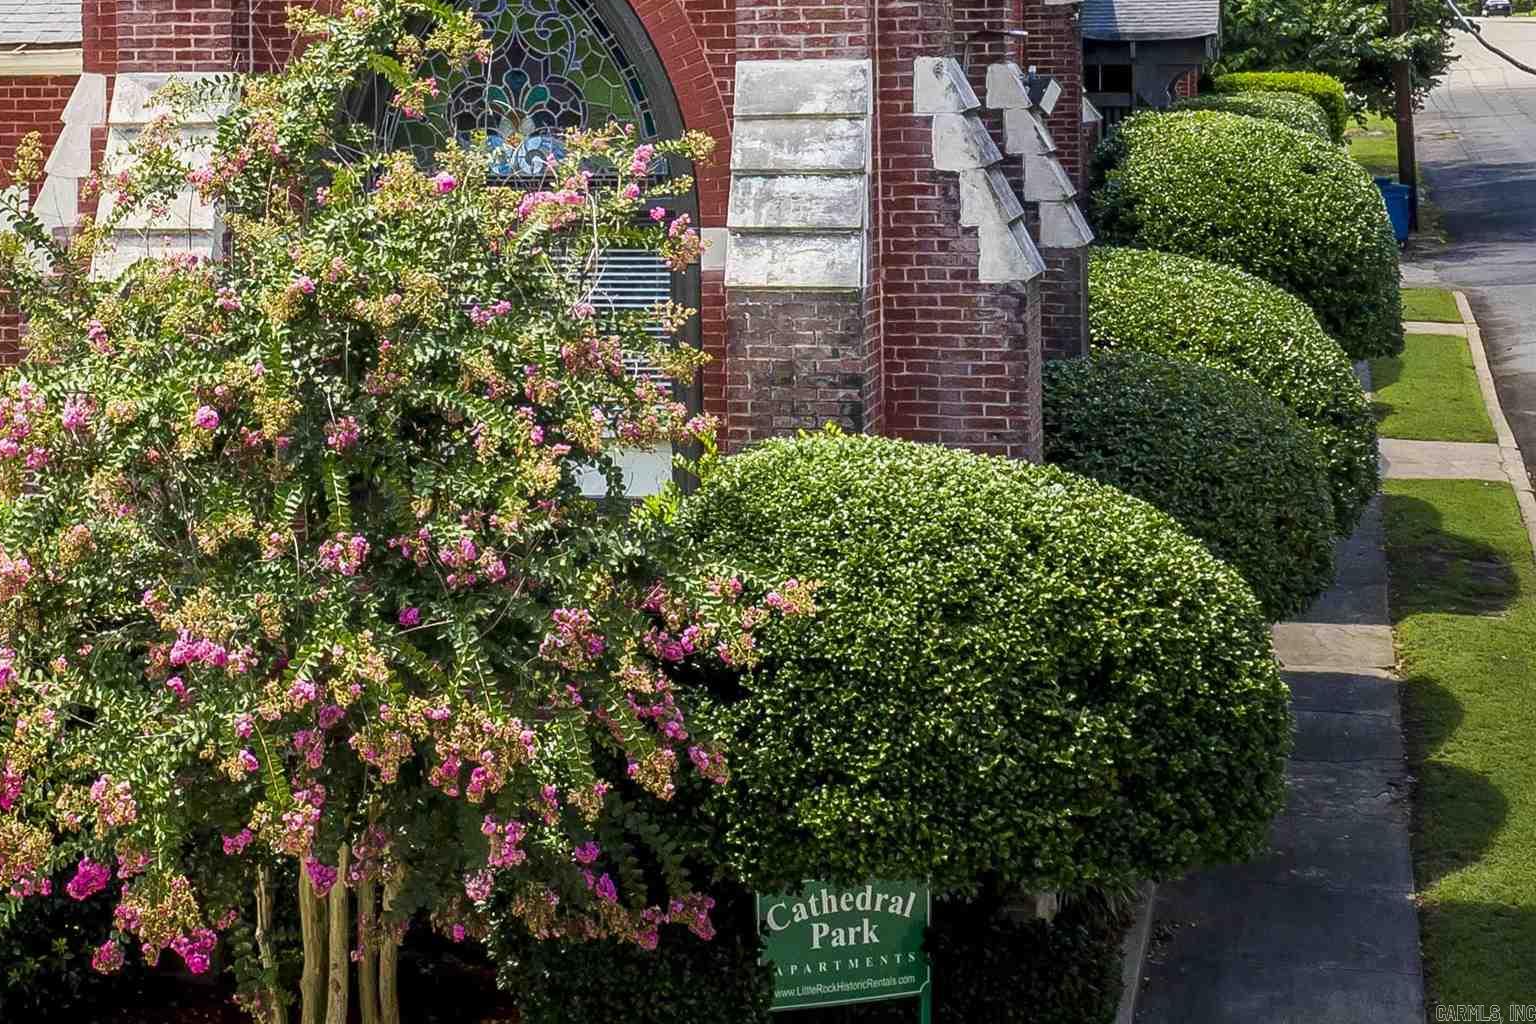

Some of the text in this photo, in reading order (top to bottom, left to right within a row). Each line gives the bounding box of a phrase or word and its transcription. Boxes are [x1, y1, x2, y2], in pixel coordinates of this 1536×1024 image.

[766, 885, 916, 931] Cathedral
[810, 918, 880, 950] Park
[775, 952, 916, 976] APARTMENTS
